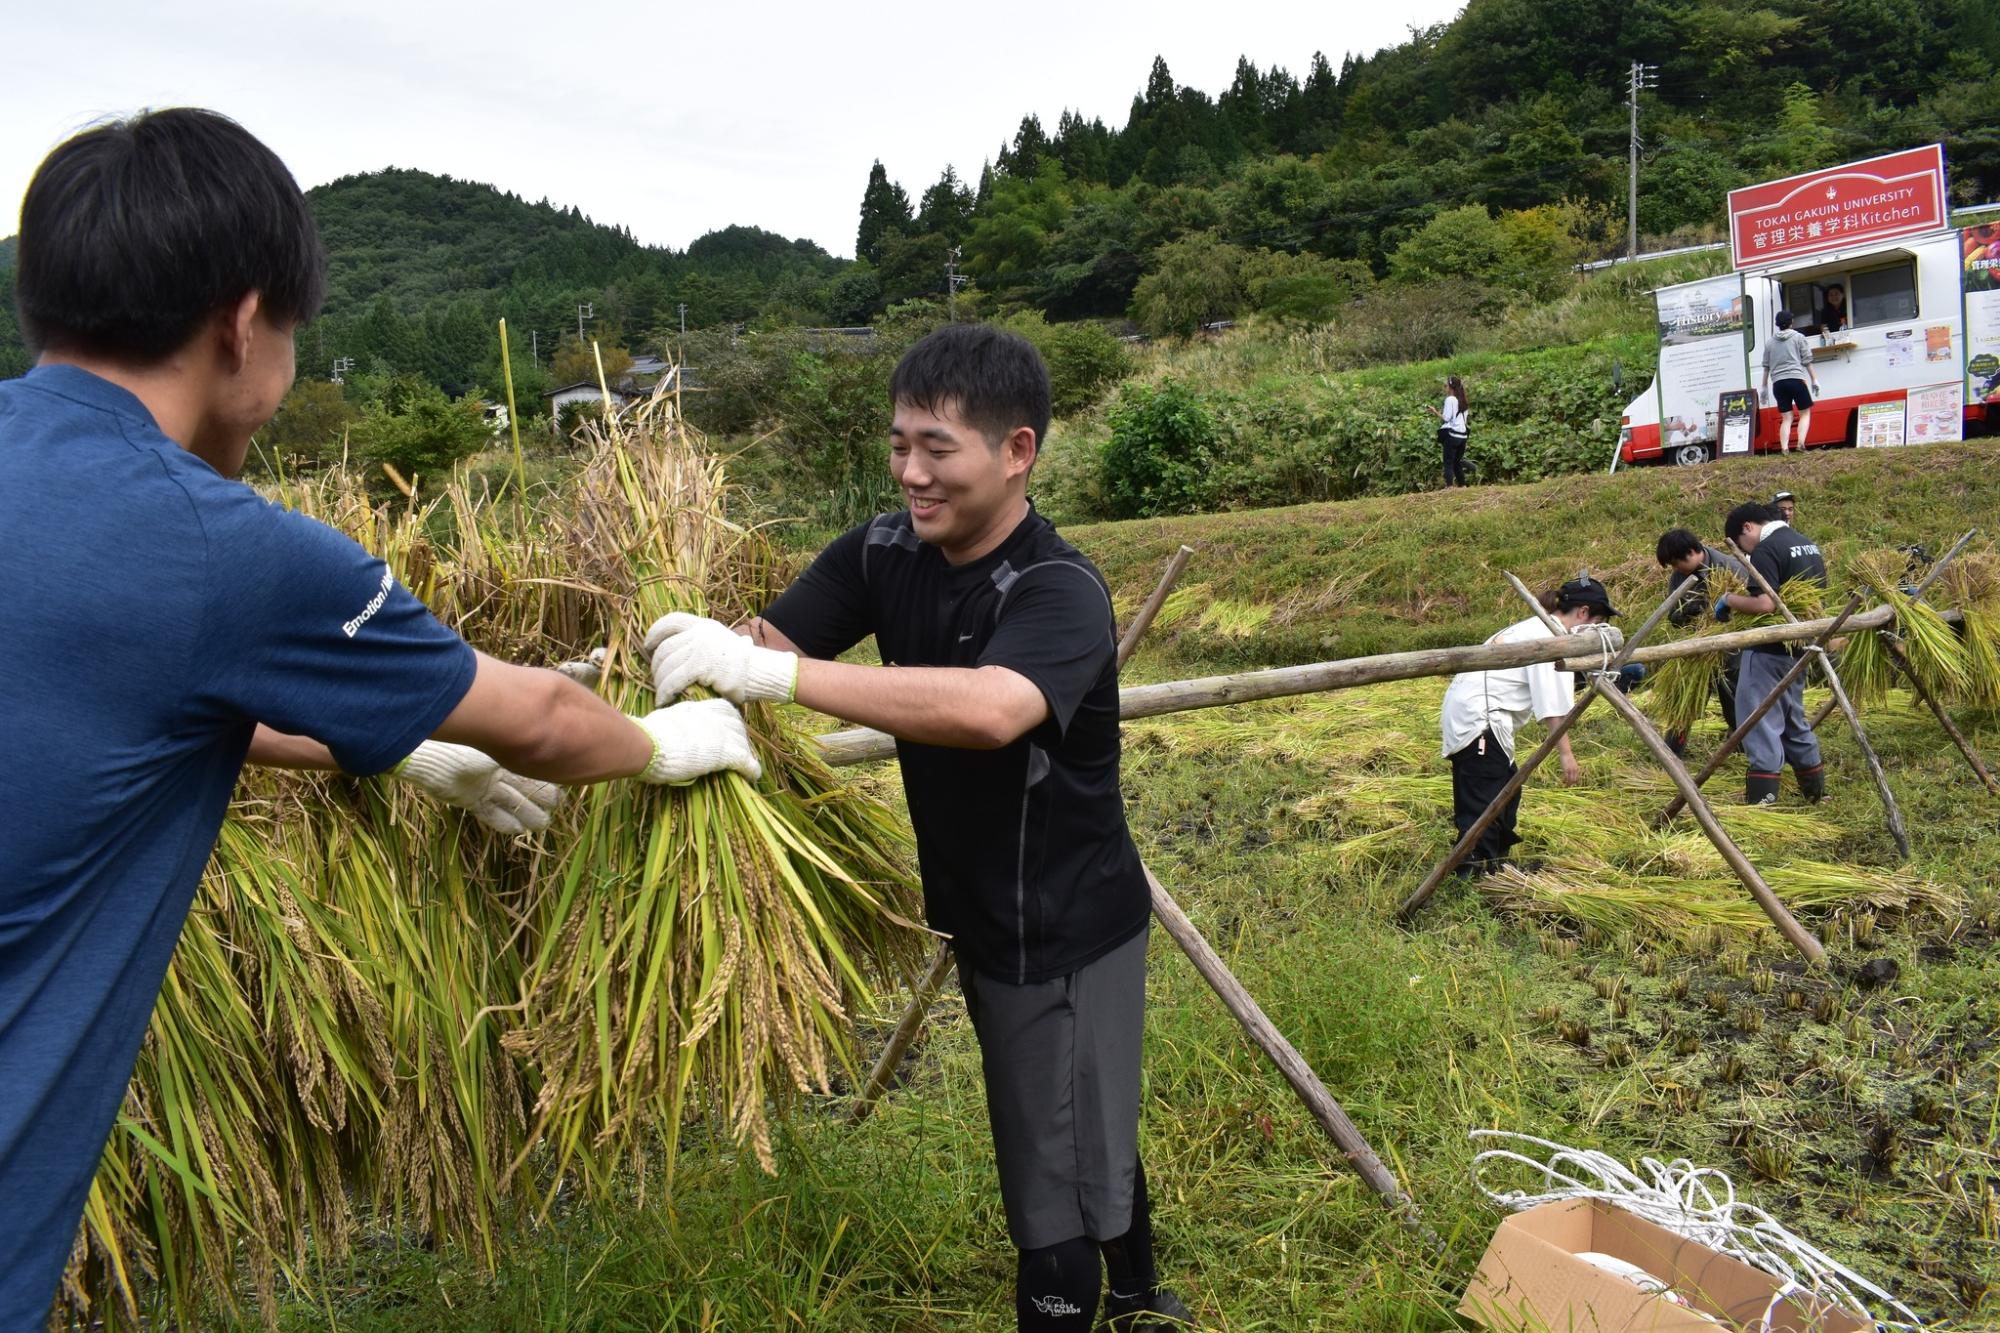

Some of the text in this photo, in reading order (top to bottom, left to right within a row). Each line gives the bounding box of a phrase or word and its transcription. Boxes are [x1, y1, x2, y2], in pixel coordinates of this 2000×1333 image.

[1756, 187, 1913, 229] TOKAI GAKUIN UNIVERSITY
